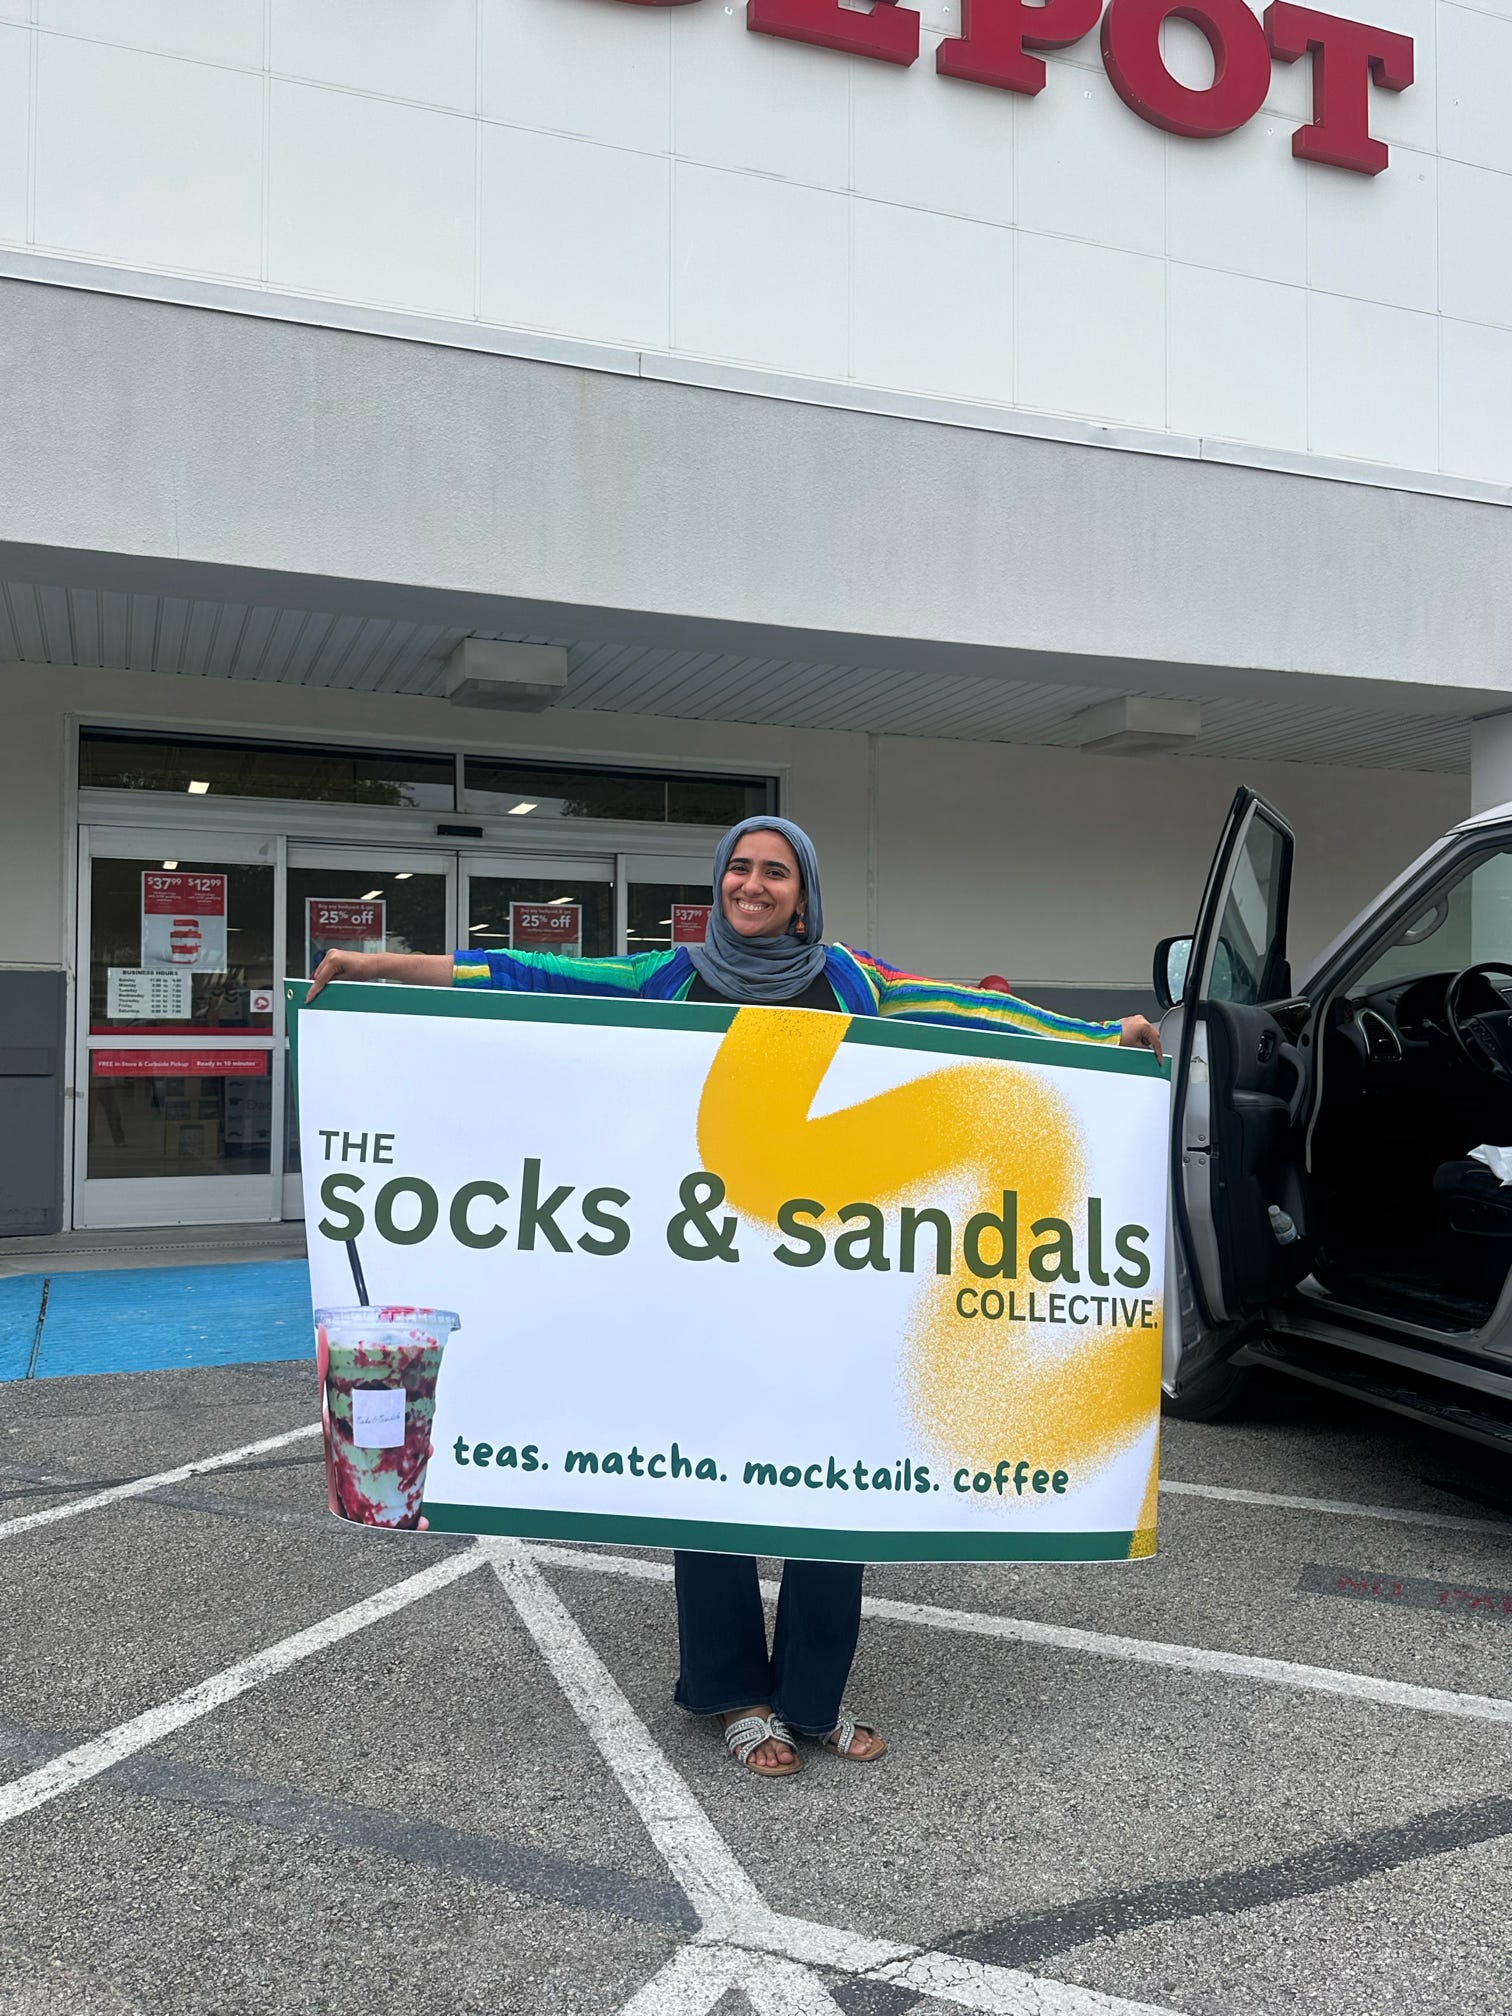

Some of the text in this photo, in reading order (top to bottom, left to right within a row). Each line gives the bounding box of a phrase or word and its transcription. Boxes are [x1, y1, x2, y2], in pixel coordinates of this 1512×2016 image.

[610, 0, 1415, 177] POT
[320, 910, 374, 925] 25% off
[522, 914, 572, 928] 25% off
[318, 1130, 395, 1165] THE
[318, 1157, 1151, 1289] socks & sandals
[956, 1287, 1158, 1329] COLLECTIVE.
[453, 1435, 1069, 1496] teas. matcha. mocktails. coffee
